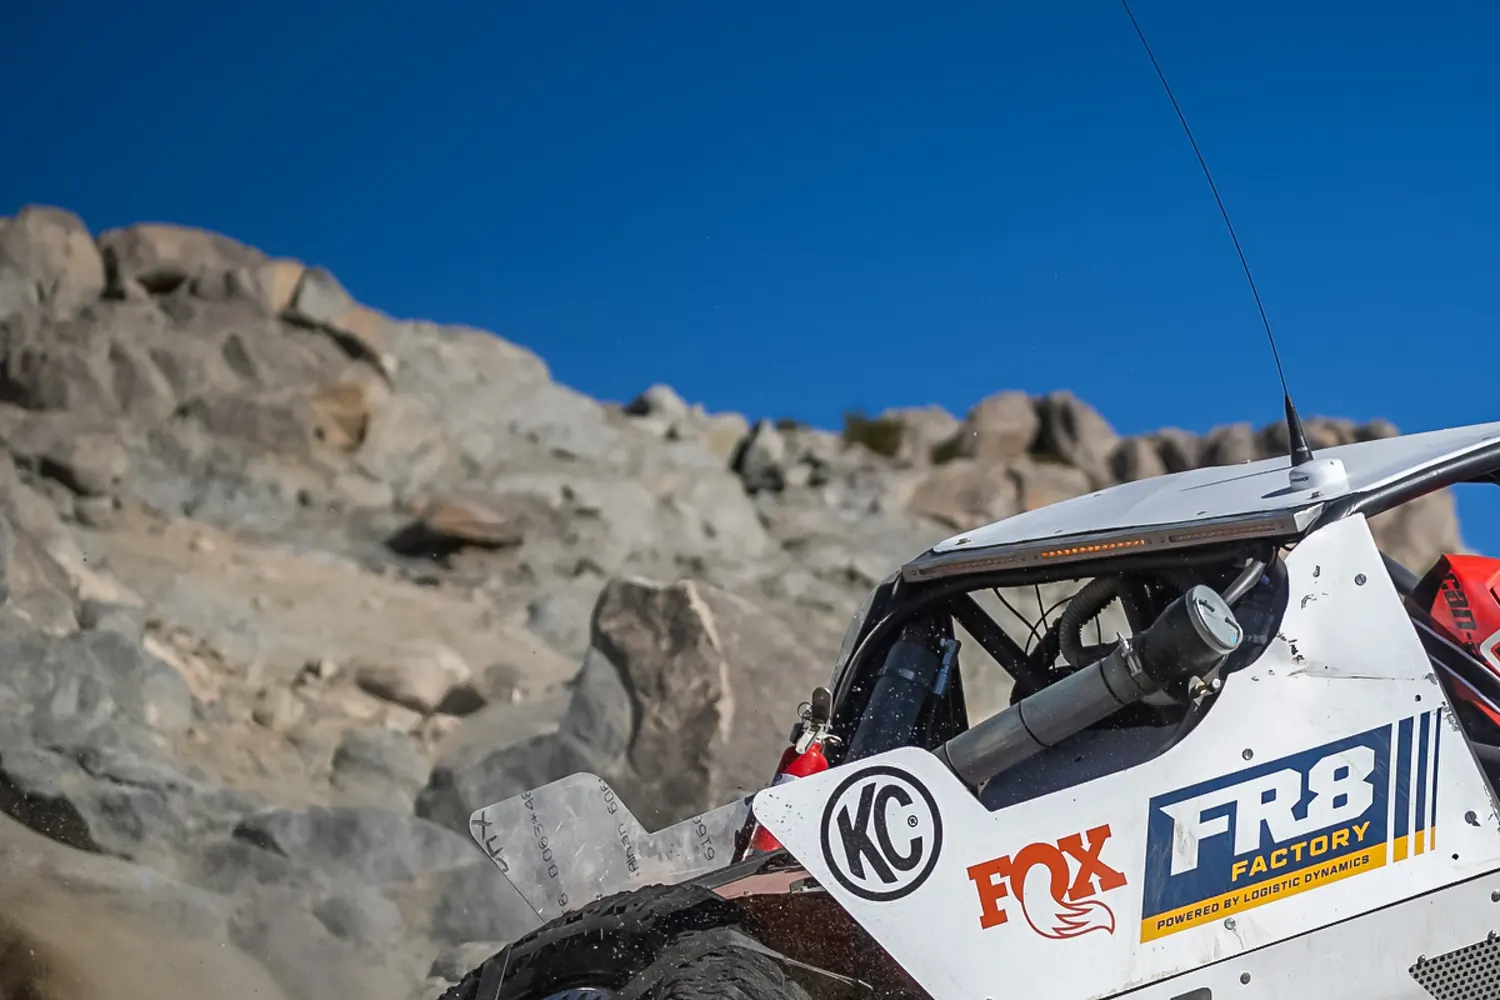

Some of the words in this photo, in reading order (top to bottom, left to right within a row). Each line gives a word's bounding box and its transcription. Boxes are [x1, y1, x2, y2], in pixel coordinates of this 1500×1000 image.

[838, 781, 924, 885] KC
[1159, 743, 1376, 877] FR8
[1231, 820, 1371, 882] FACTORY
[966, 823, 1128, 940] FOX
[1156, 902, 1220, 930] POWERED
[1224, 895, 1240, 909] BY
[1244, 876, 1301, 903] LOGISTIC
[1304, 854, 1370, 884] DYNAMICS
